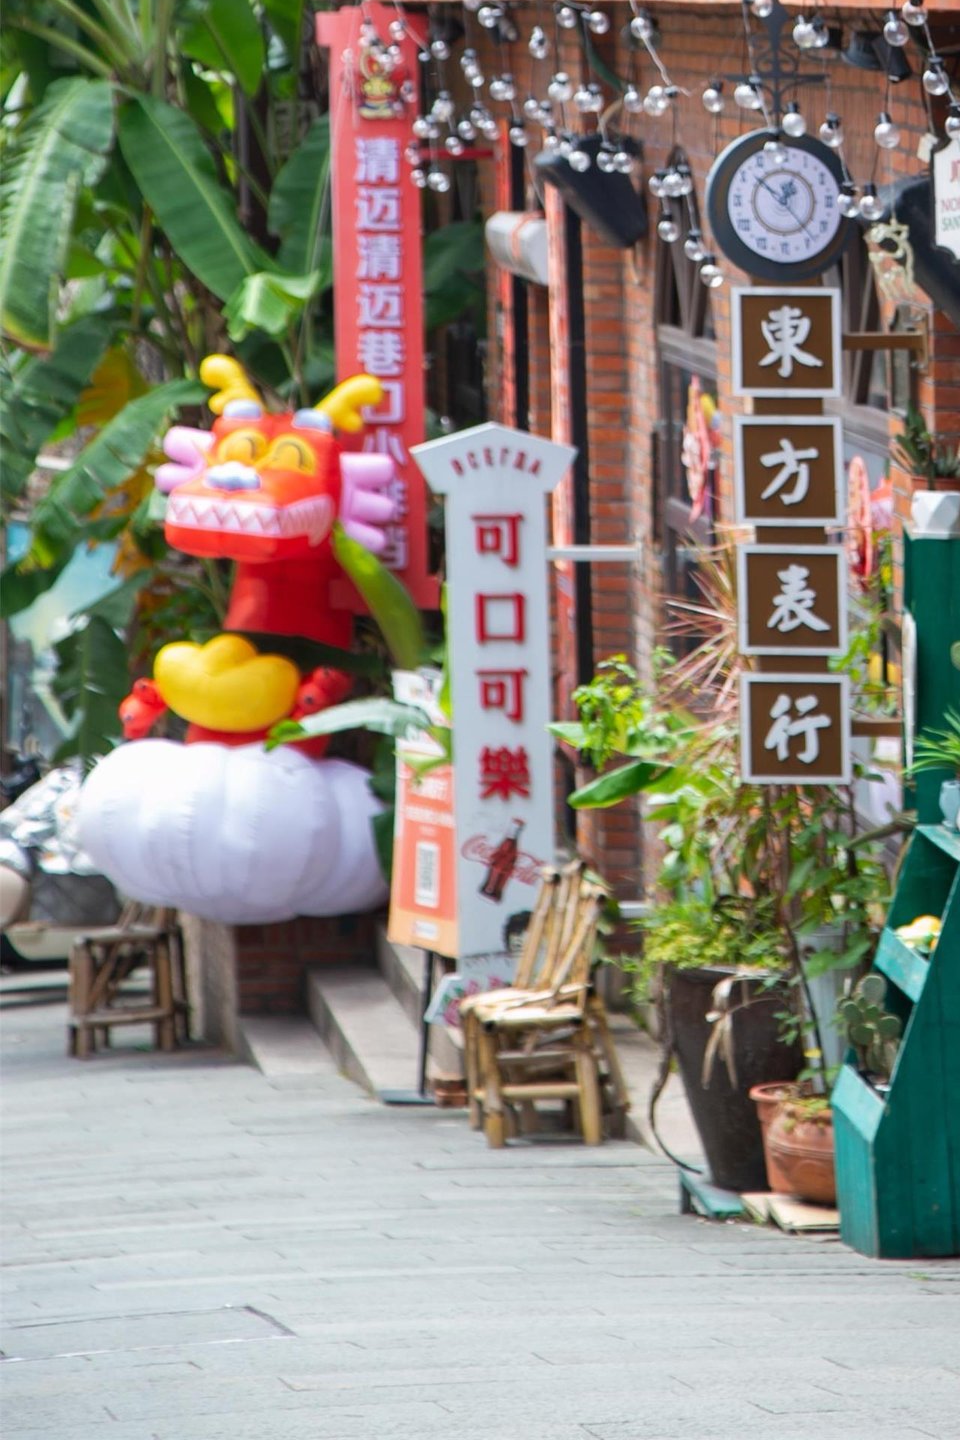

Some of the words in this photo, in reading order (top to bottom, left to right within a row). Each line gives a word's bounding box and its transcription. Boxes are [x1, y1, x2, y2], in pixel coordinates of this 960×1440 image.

[471, 513, 533, 803] 可口可樂
[758, 304, 831, 765] 東方表行
